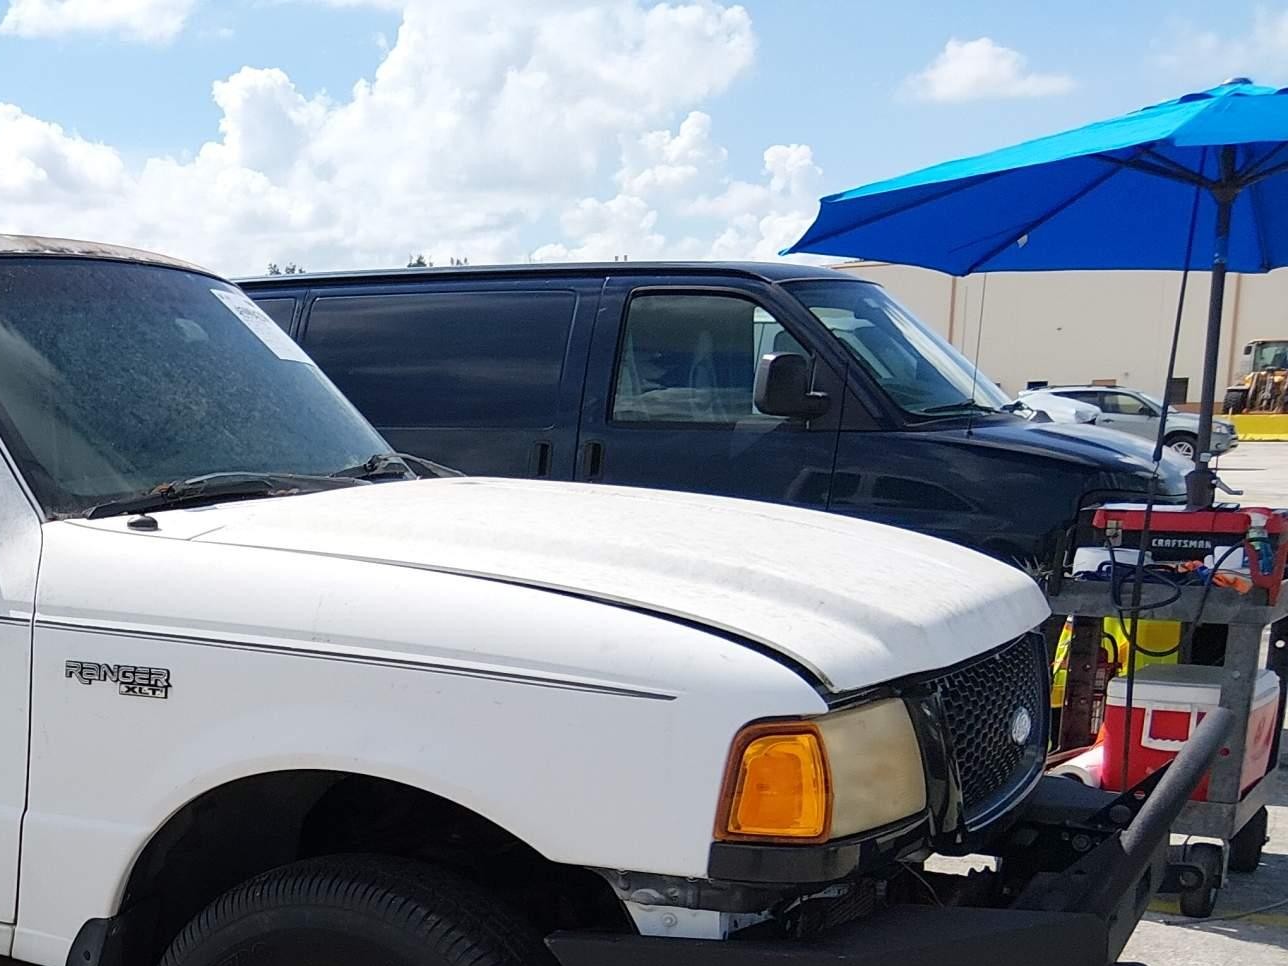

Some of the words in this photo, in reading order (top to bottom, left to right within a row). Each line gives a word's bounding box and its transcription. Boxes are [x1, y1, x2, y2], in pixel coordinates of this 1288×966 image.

[1151, 538, 1212, 549] CRAFTSMAN
[65, 660, 171, 687] RANGER
[123, 685, 165, 697] XLT
